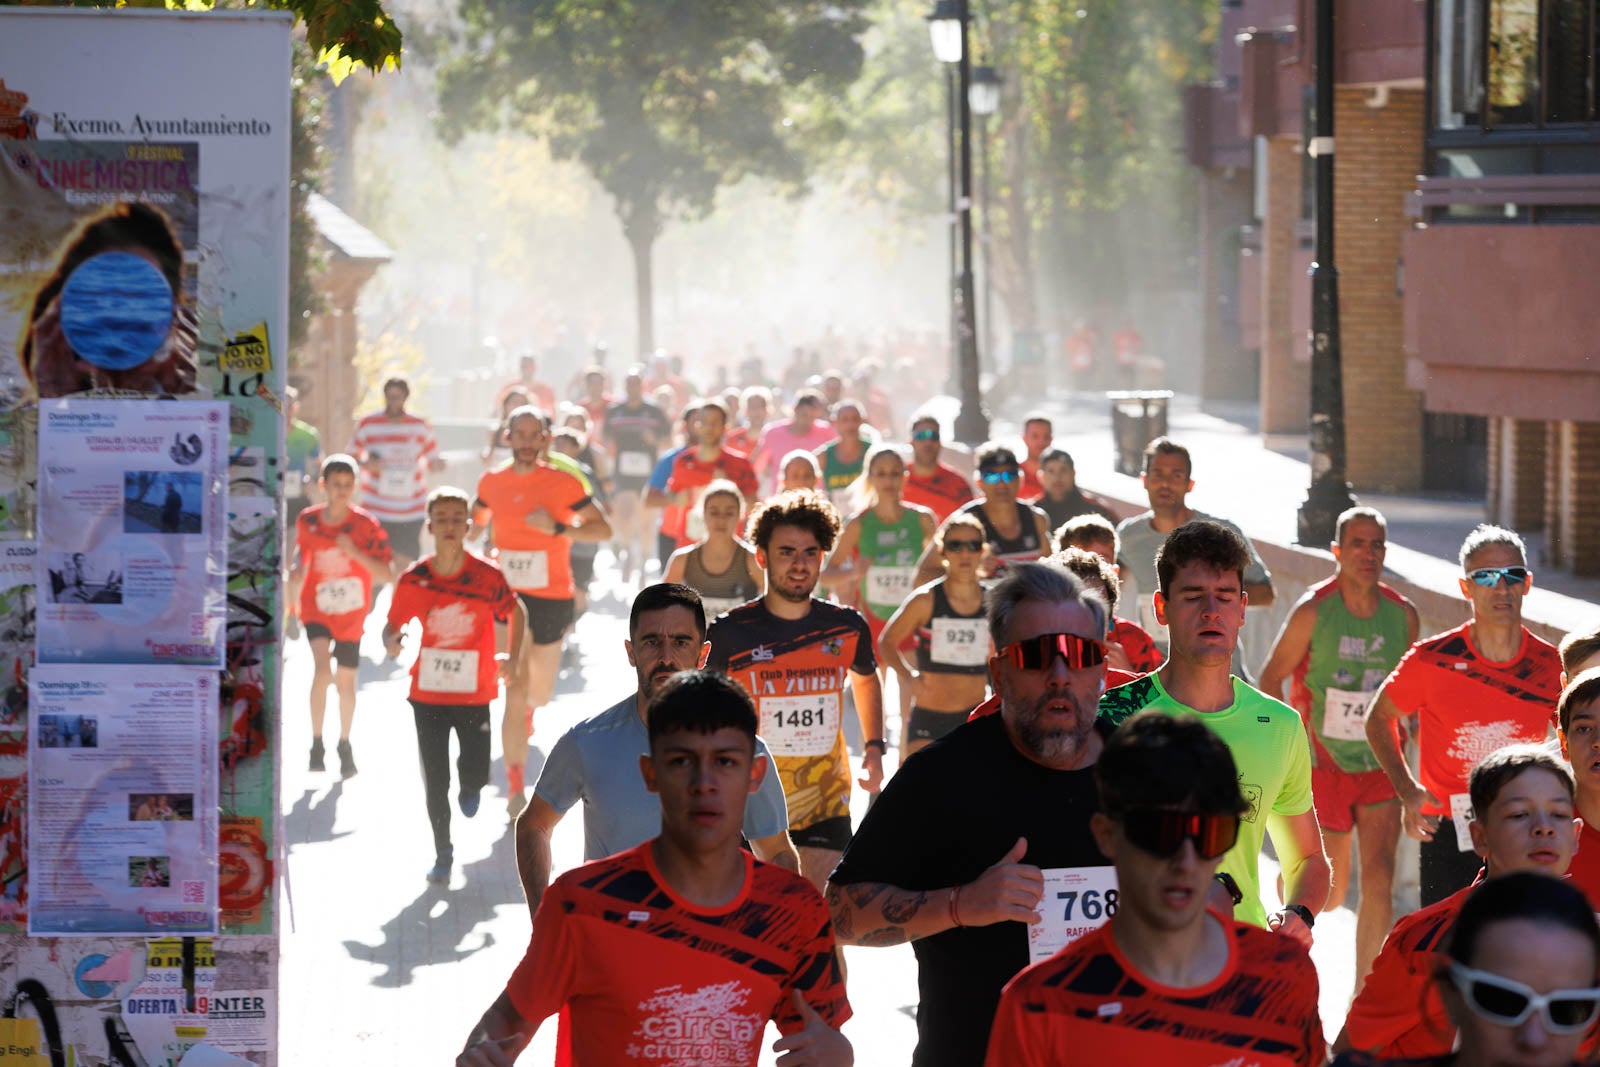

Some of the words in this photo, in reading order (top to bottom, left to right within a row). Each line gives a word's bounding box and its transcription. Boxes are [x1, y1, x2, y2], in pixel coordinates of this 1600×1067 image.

[53, 112, 123, 134] Excmo.
[130, 113, 271, 141] Ayuntamiento
[66, 190, 116, 204] Espejos
[121, 189, 136, 202] de
[140, 189, 176, 202] Amor
[246, 343, 265, 355] NO
[227, 355, 265, 369] VOTO
[946, 629, 976, 643] 929
[760, 670, 783, 680] Club
[786, 666, 836, 678] Deportivo
[773, 708, 824, 728] 1481
[1056, 889, 1119, 921] 768
[128, 999, 177, 1014] OFERTA
[642, 1016, 754, 1041] carrera
